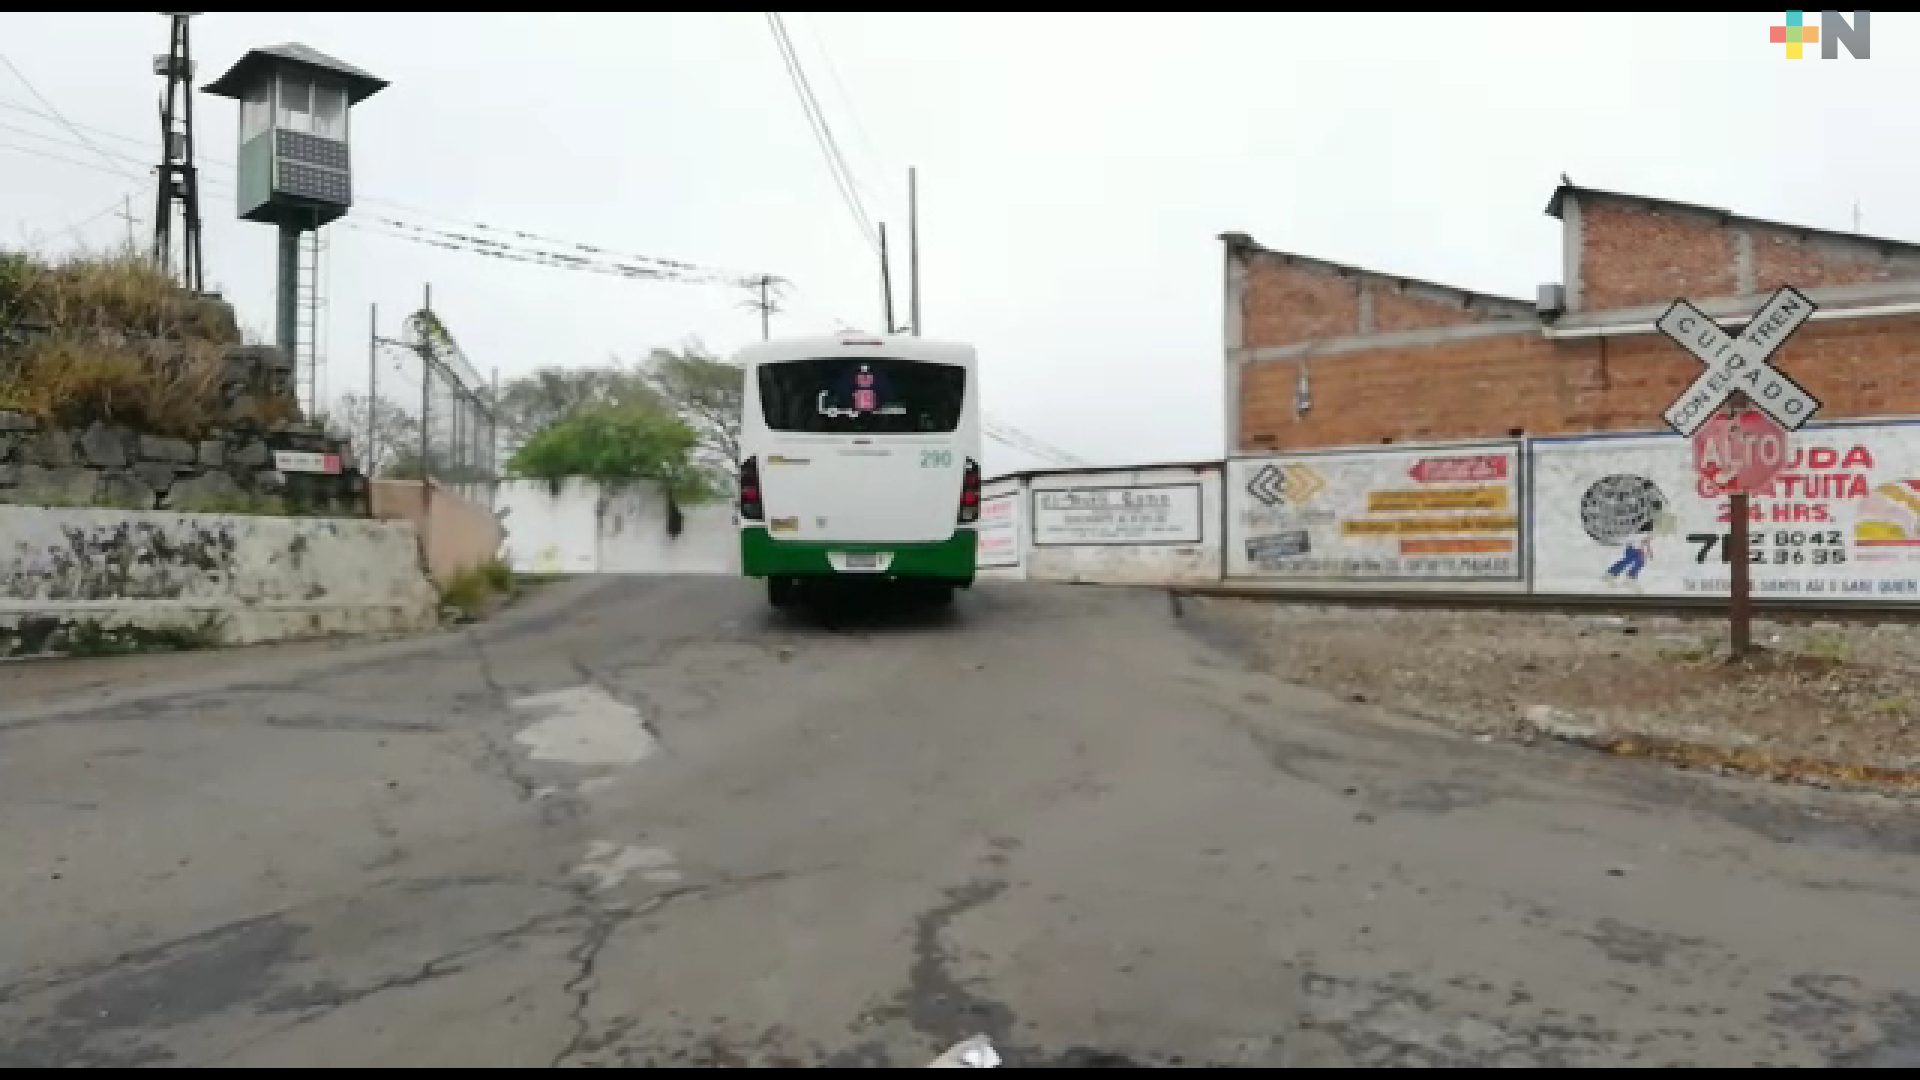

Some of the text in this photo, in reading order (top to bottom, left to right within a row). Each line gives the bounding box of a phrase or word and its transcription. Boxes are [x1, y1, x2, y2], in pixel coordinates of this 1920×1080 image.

[1674, 389, 1711, 427] CON
[1746, 297, 1801, 348] TREN
[1677, 317, 1803, 415] CUIDADO
[920, 450, 952, 469] 290
[1701, 434, 1780, 470] ALTO
